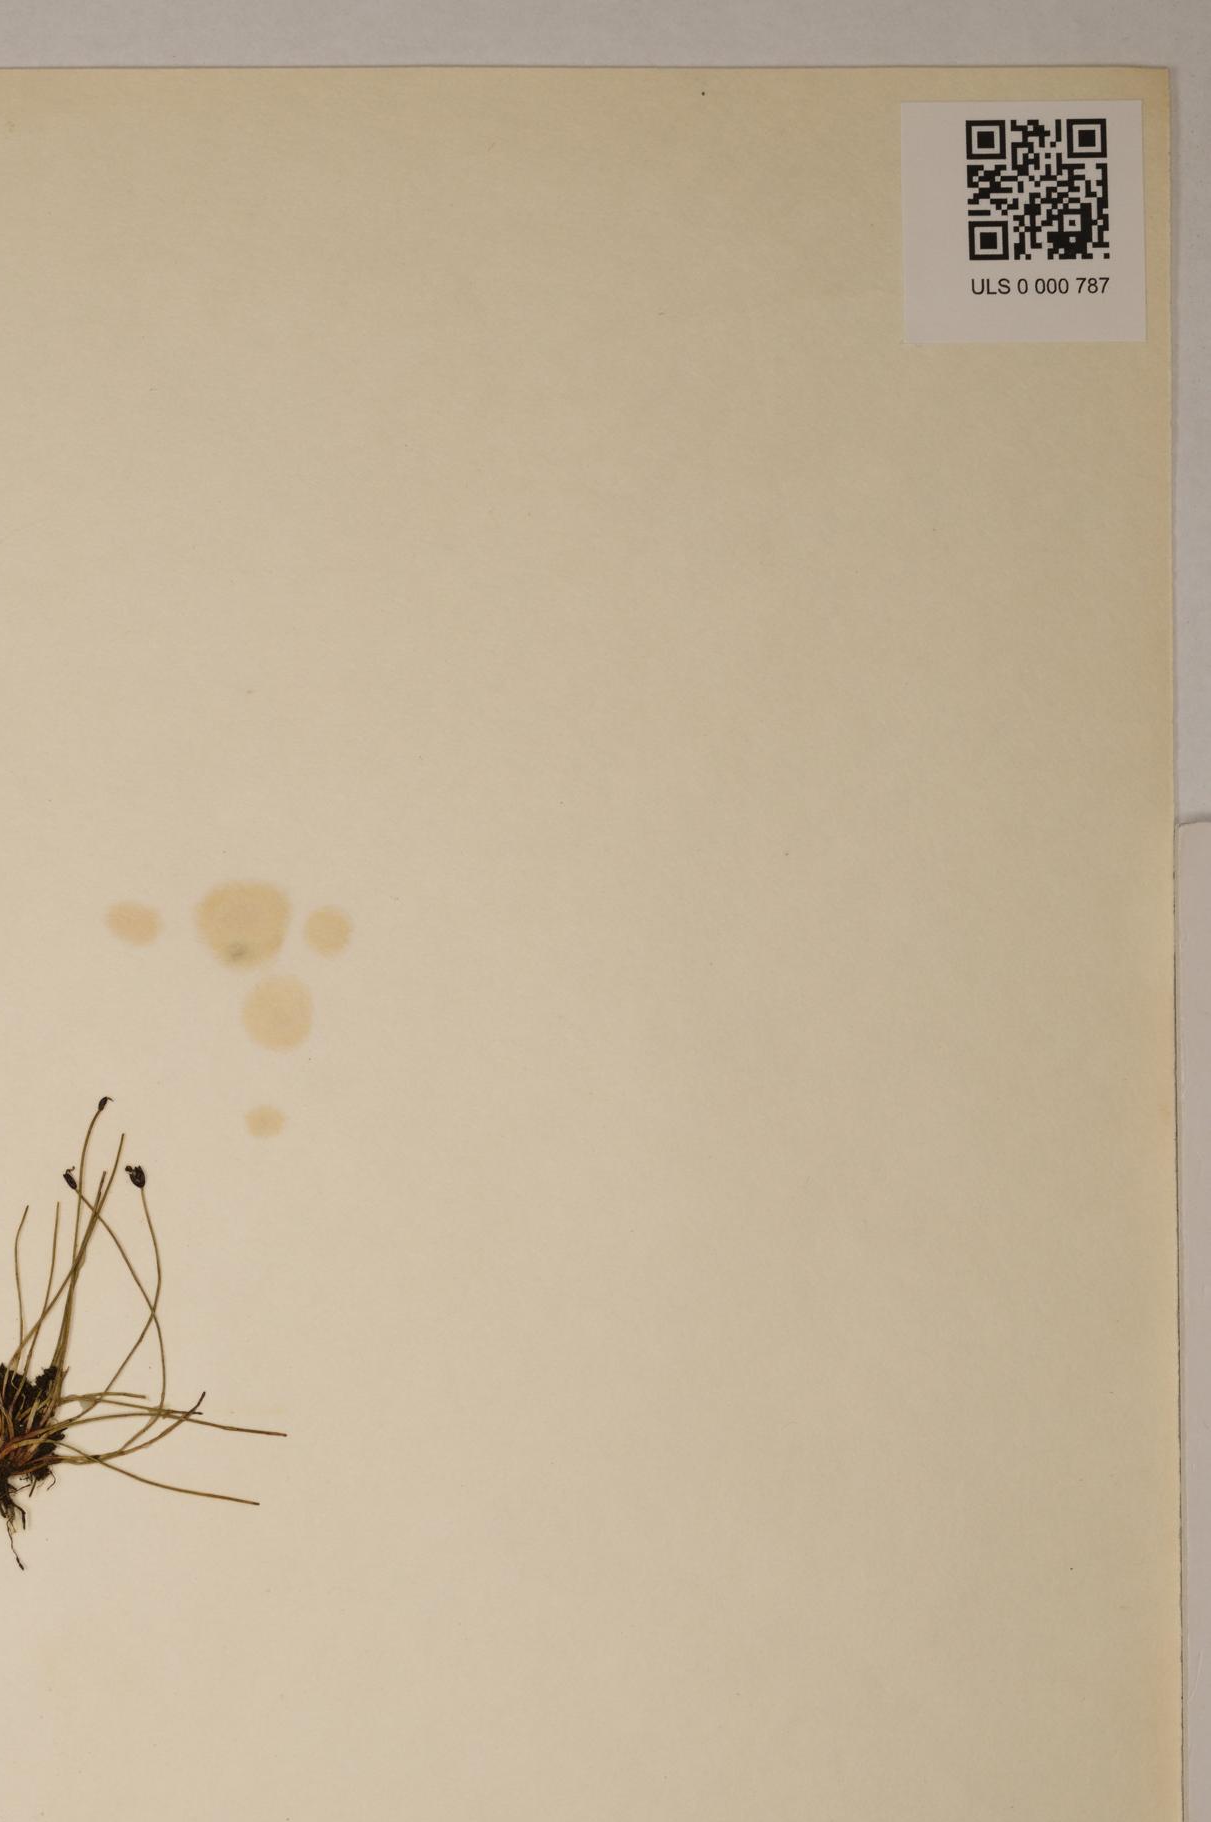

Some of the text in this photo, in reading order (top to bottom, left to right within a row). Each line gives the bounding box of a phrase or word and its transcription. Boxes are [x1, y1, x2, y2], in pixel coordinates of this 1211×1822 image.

[971, 276, 1110, 296] ULS 0 000 787
